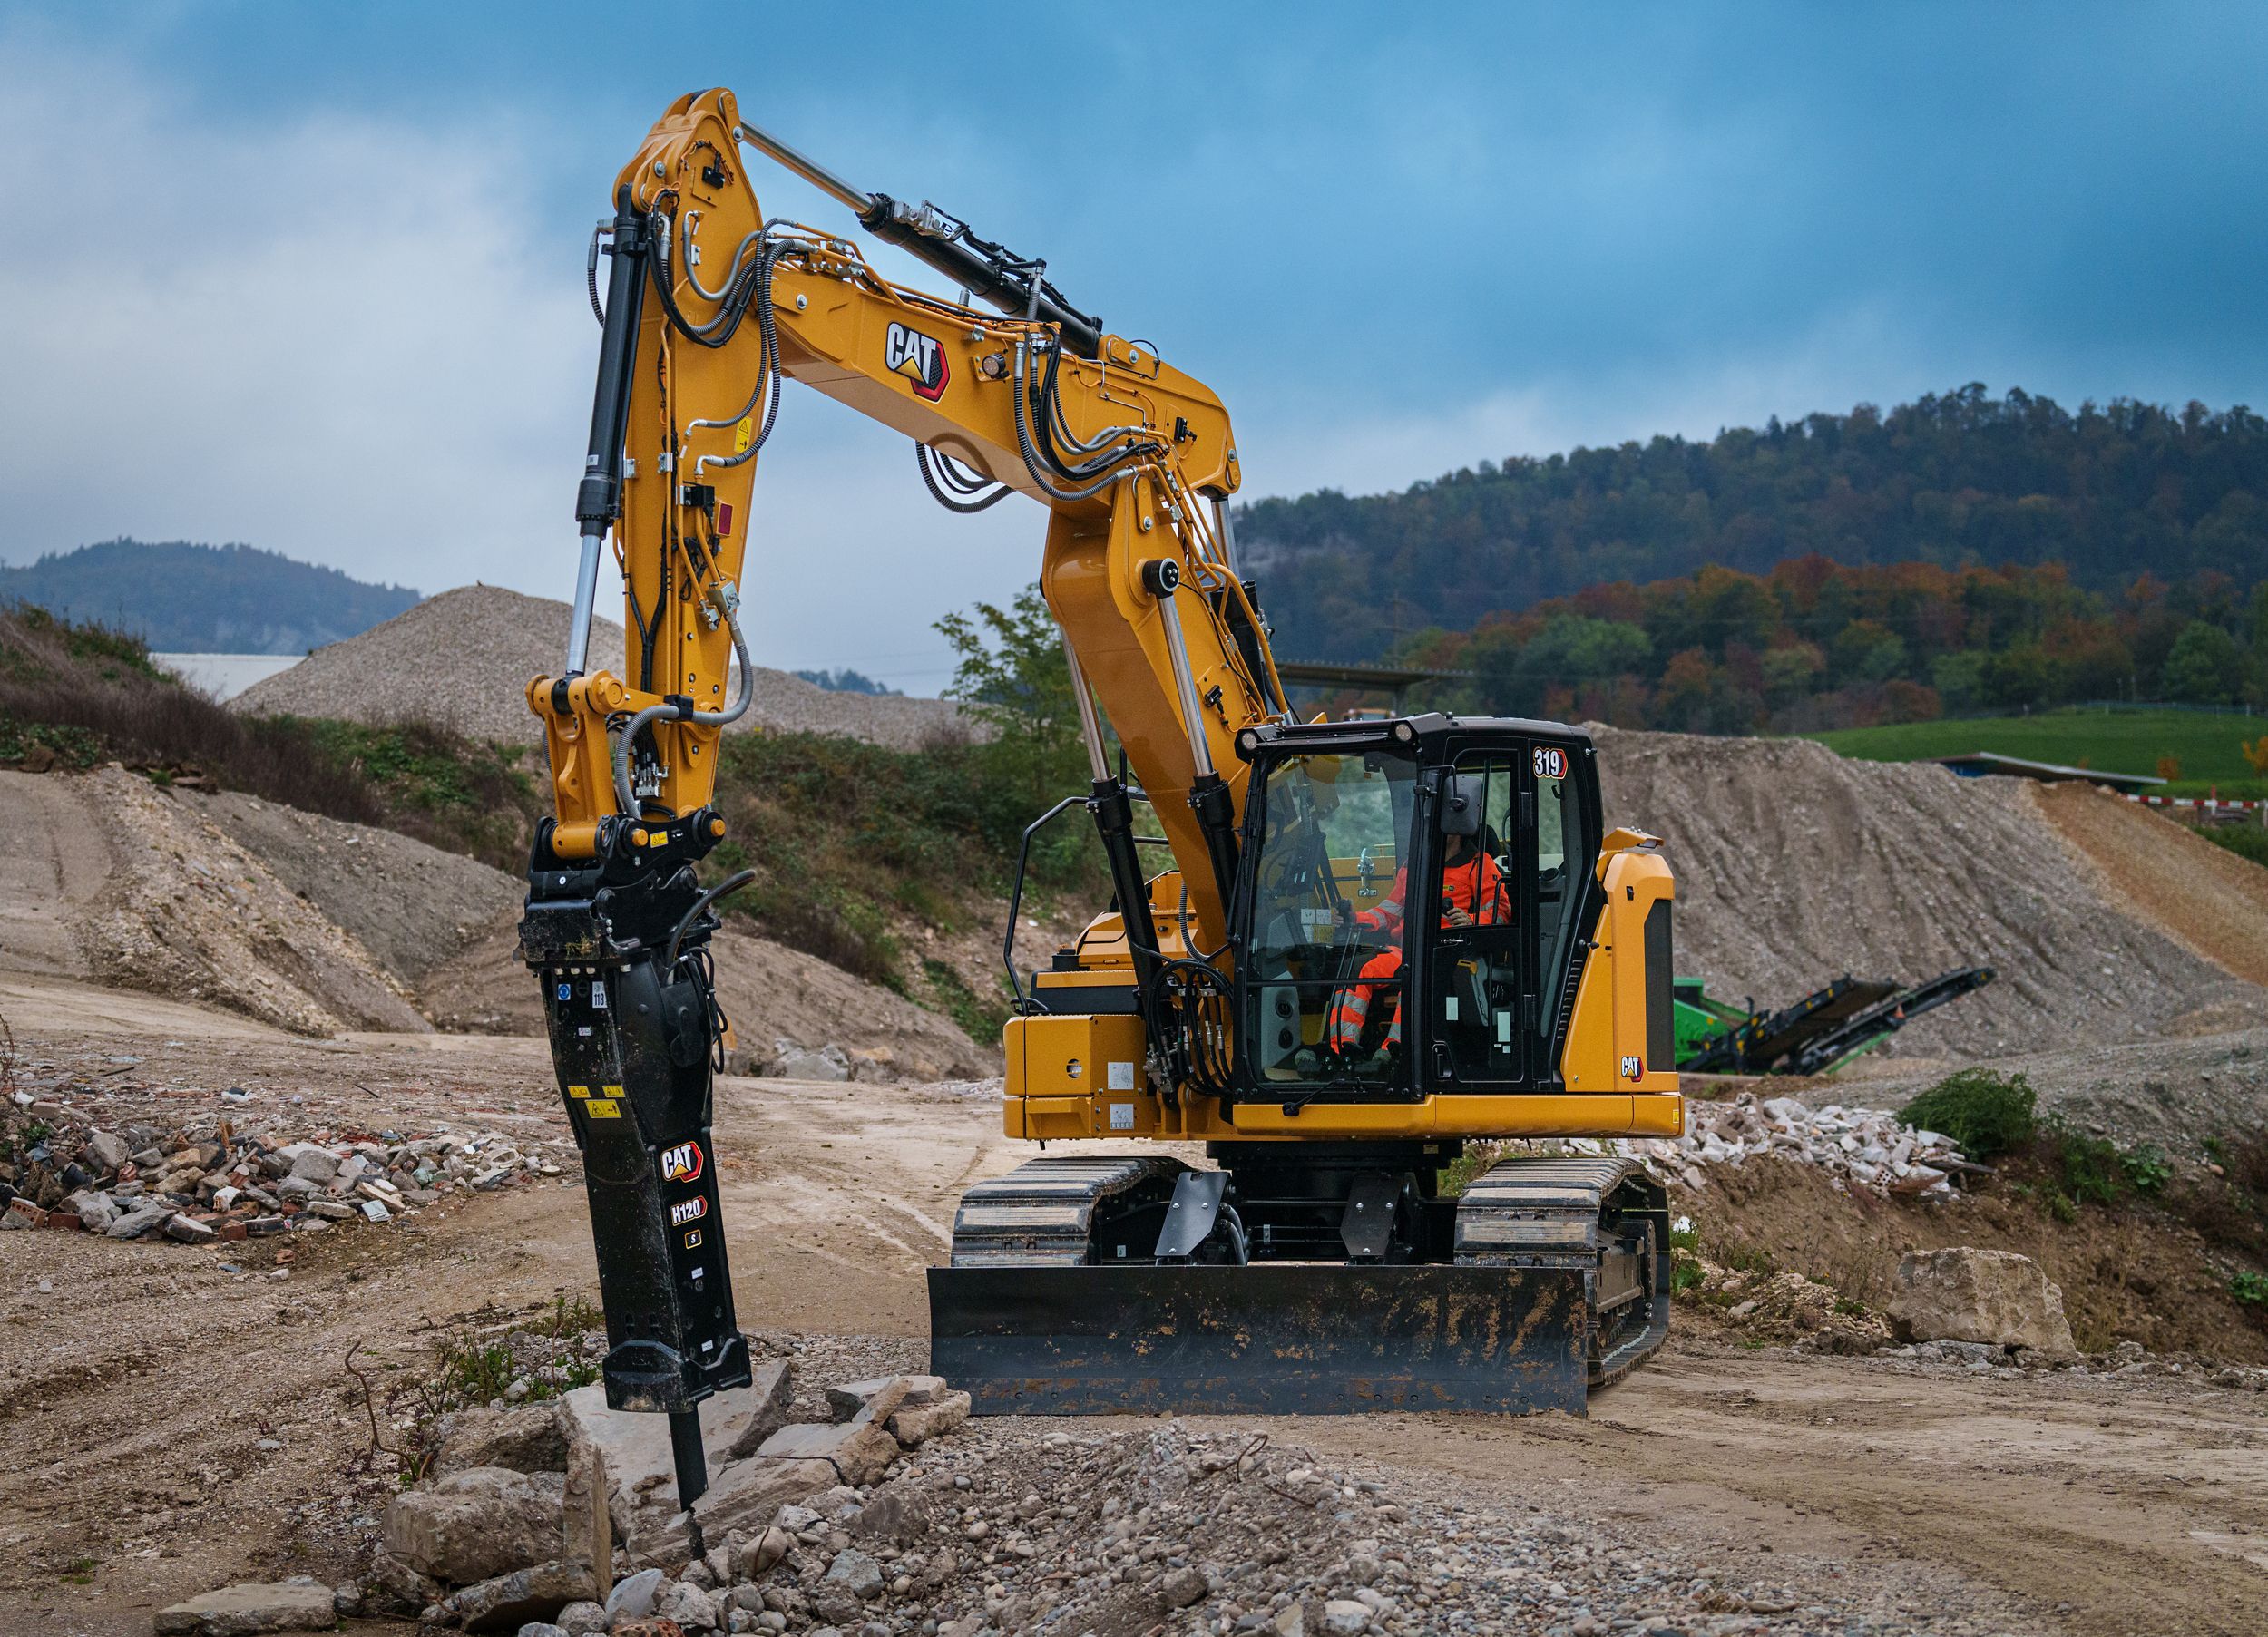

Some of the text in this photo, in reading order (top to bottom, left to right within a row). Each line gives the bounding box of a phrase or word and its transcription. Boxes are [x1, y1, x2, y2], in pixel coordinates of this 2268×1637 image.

[886, 322, 936, 384] CAT
[1534, 749, 1559, 776] 319
[594, 993, 604, 1006] 118
[1621, 1057, 1639, 1077] CAT
[662, 1144, 692, 1179] CAT
[672, 1199, 700, 1224] H120
[690, 1233, 696, 1243] S
